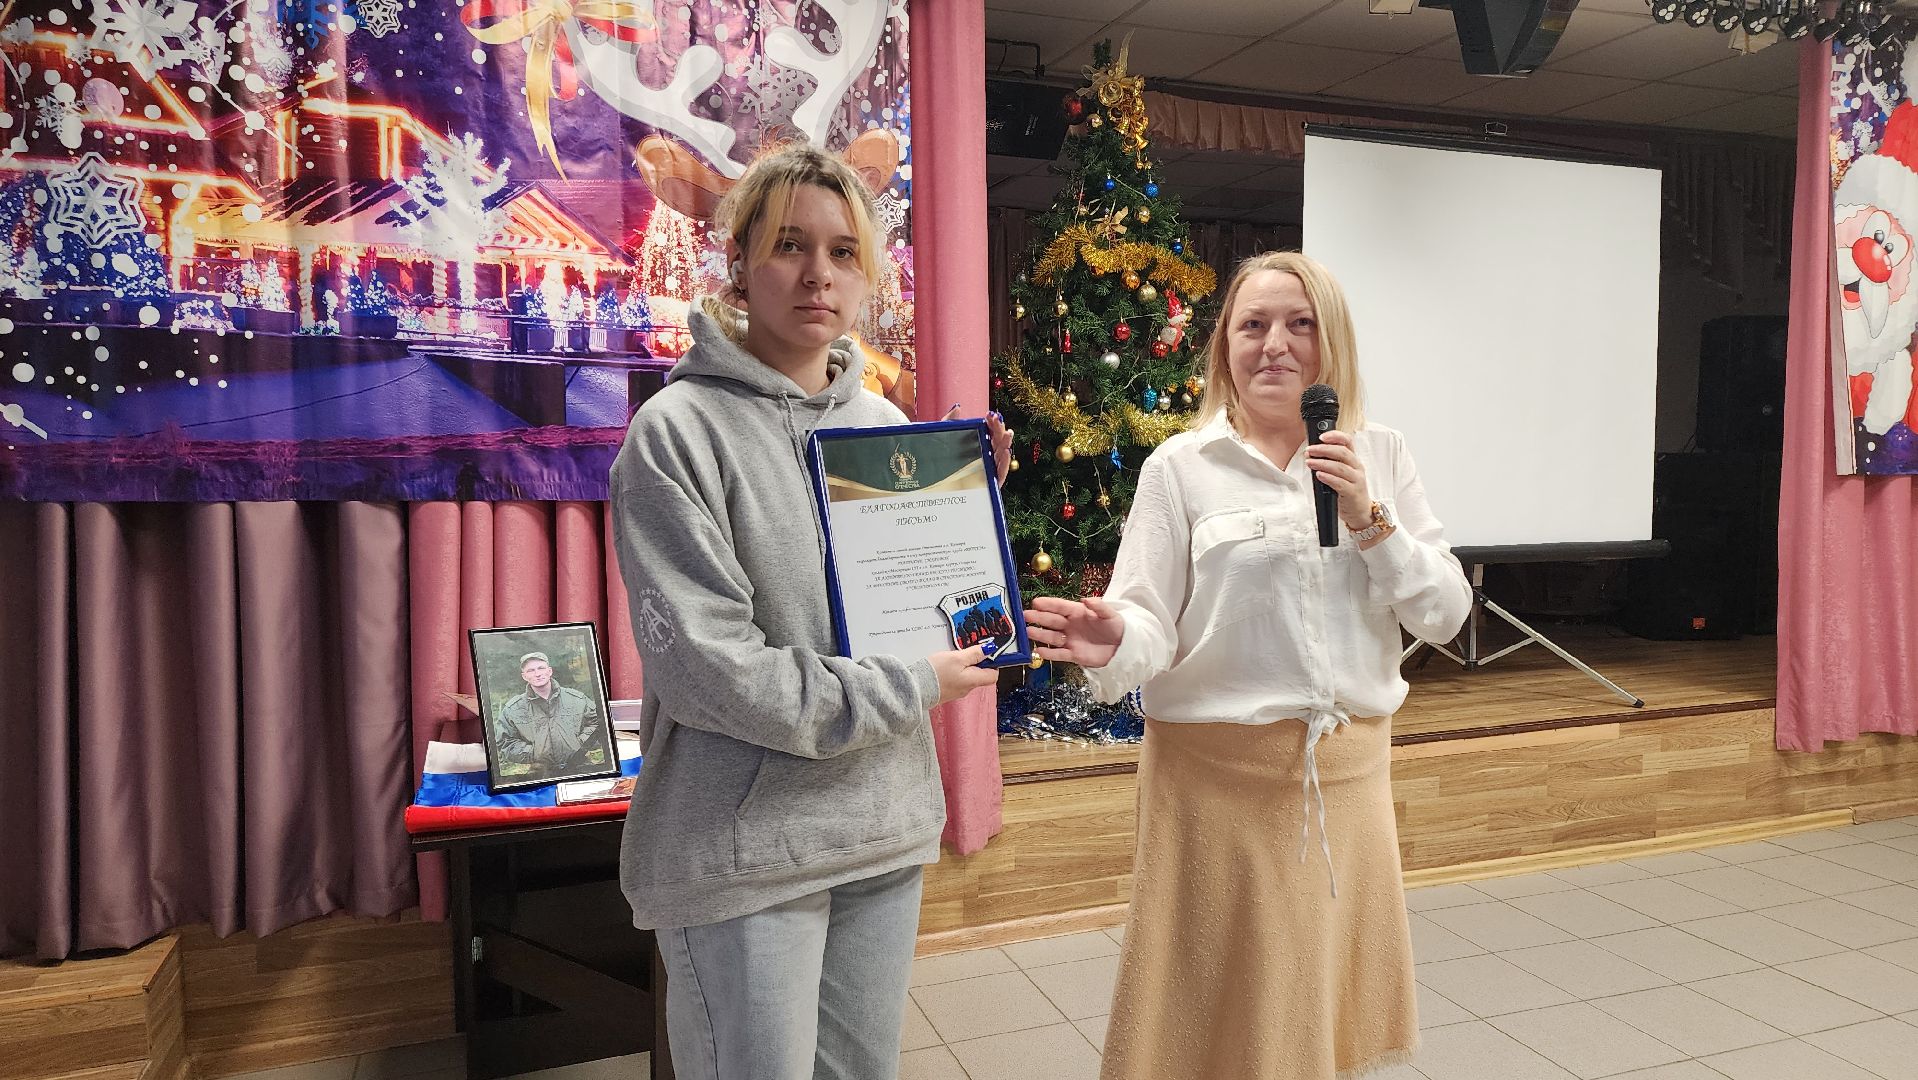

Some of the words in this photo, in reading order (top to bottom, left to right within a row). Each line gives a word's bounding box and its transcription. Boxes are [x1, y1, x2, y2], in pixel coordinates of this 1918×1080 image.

[859, 496, 967, 514] БЛАГОДАРСТВЕННОЕ
[895, 514, 938, 526] ПИСЬМО
[955, 590, 989, 607] РОДНЯ
